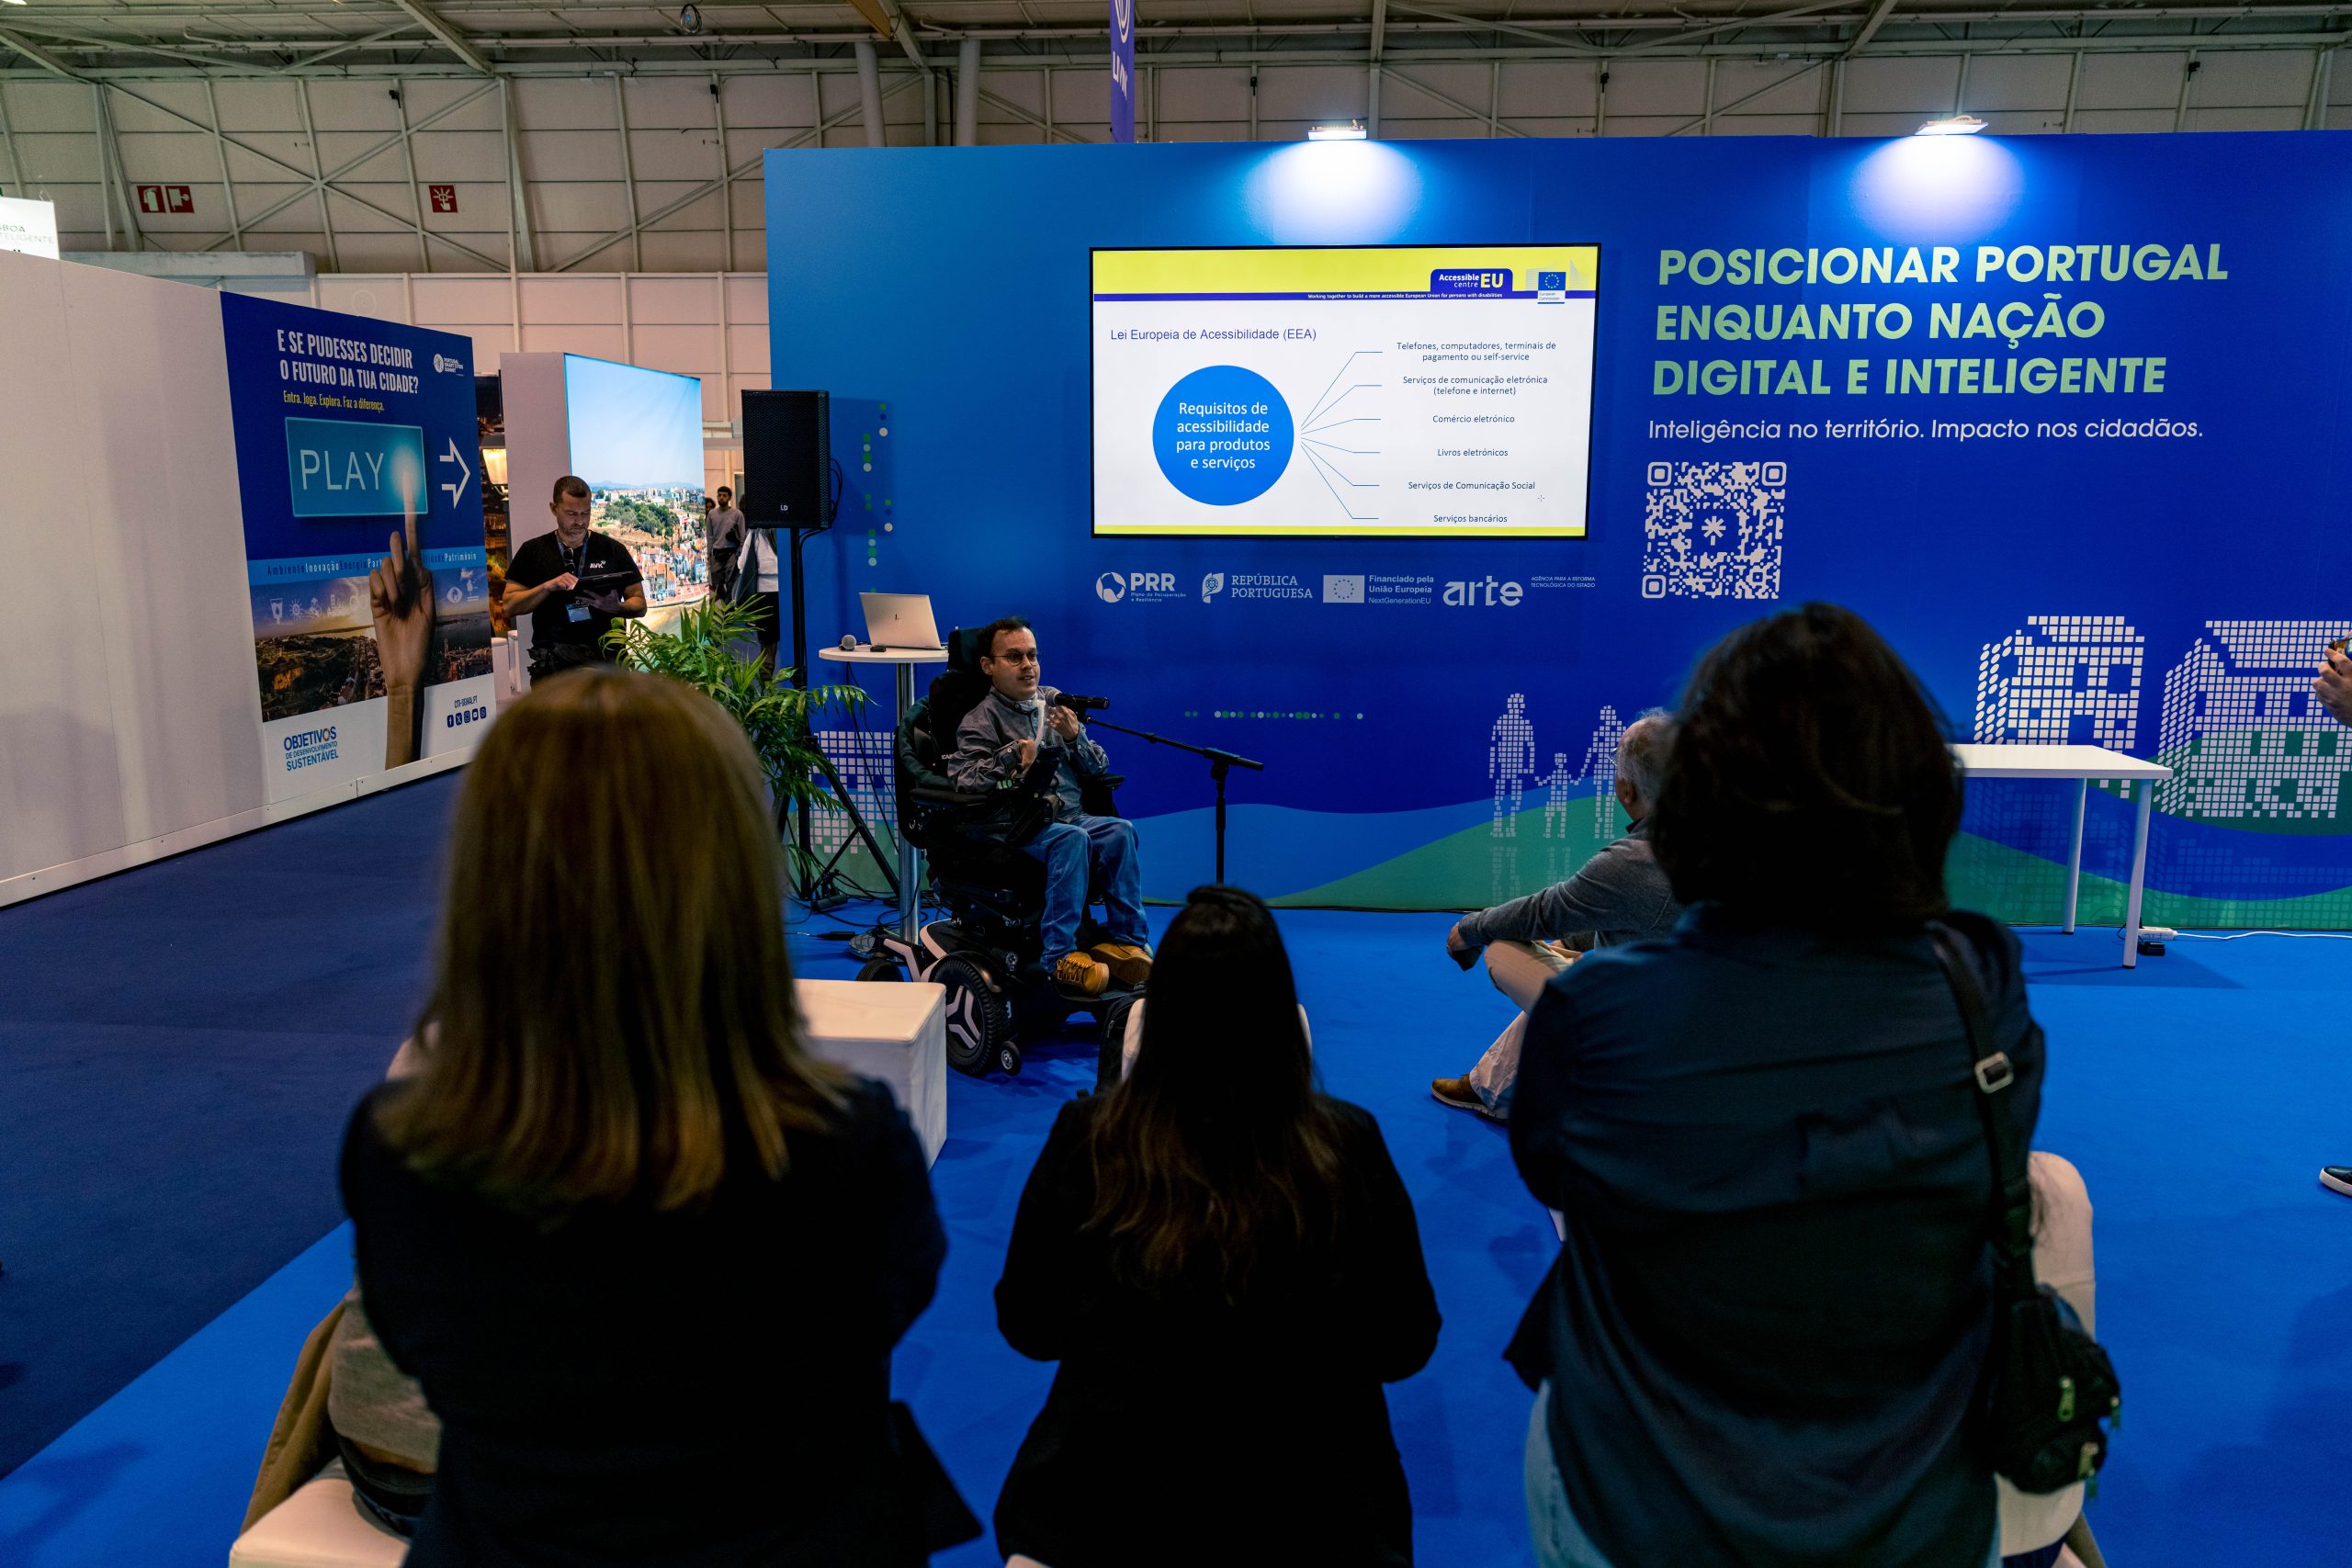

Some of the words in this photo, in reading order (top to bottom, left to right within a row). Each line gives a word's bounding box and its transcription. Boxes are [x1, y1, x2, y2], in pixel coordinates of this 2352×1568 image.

[1658, 246, 1960, 286] POSICIONAR
[1975, 243, 2228, 283] PORTUGAL
[1481, 273, 1504, 288] EU
[1656, 303, 1913, 341] ENQUANTO
[1929, 292, 2105, 349] NAÇÃO
[1111, 329, 1127, 340] Lei
[1131, 330, 1179, 342] Europeia
[1183, 329, 1197, 339] de
[1200, 329, 1279, 340] Acessibilidade
[1283, 328, 1317, 341] (EEA)
[277, 329, 286, 352] E
[288, 331, 305, 355] SE
[307, 333, 368, 363] PUDESSES
[370, 343, 413, 369] DECIDIR
[1397, 342, 1439, 351] Telefones,
[1441, 342, 1502, 351] computadores,
[1423, 354, 1469, 362] pagamento
[280, 360, 289, 380] O
[292, 361, 337, 385] FUTURO
[339, 367, 355, 387] DA
[356, 369, 377, 390] TUA
[379, 372, 419, 394] CIDADE?
[1403, 376, 1436, 385] Serviços
[1450, 376, 1504, 385] comunicação
[1653, 359, 1831, 396] DIGITAL
[1847, 359, 1869, 395] E
[1885, 357, 2167, 395] INTELIGENTE
[1433, 387, 1471, 395] (telefone
[1480, 387, 1516, 395] internet)
[283, 390, 302, 404] Entra.
[303, 392, 318, 407] Joga.
[319, 394, 342, 409] Explora.
[343, 396, 353, 409] Faz
[354, 400, 358, 409] a
[358, 398, 385, 413] diferença.
[1179, 402, 1247, 417] Requisitos
[1251, 401, 1268, 415] de
[1177, 420, 1269, 433] acessibilidade
[1649, 420, 1781, 443] Inteligência
[1789, 423, 1818, 438] no
[1825, 418, 1924, 439] território.
[1932, 419, 2029, 442] Impacto
[2037, 422, 2077, 438] nos
[2085, 418, 2203, 439] cidadãos.
[1176, 440, 1205, 453] para
[1210, 438, 1270, 453] produtos
[1463, 448, 1508, 456] eletrónicos
[300, 449, 384, 490] PLAY
[1190, 459, 1199, 468] e
[1202, 457, 1255, 471] serviços
[1408, 482, 1441, 491] Serviços
[1456, 481, 1510, 491] Comunicação
[1433, 515, 1467, 524] Serviços
[1130, 573, 1176, 591] PRR
[1231, 573, 1298, 586] REPÚBLICA
[1416, 575, 1434, 584] pela
[1231, 588, 1313, 598] PORTUGUESA
[1369, 585, 1392, 593] União
[1395, 585, 1432, 595] Europeia
[1443, 575, 1523, 606] arte
[284, 726, 337, 751] OBJETIVOS
[294, 741, 337, 758] DESENVOLVIMENTO
[287, 750, 338, 771] SUSTENTÁVEL
